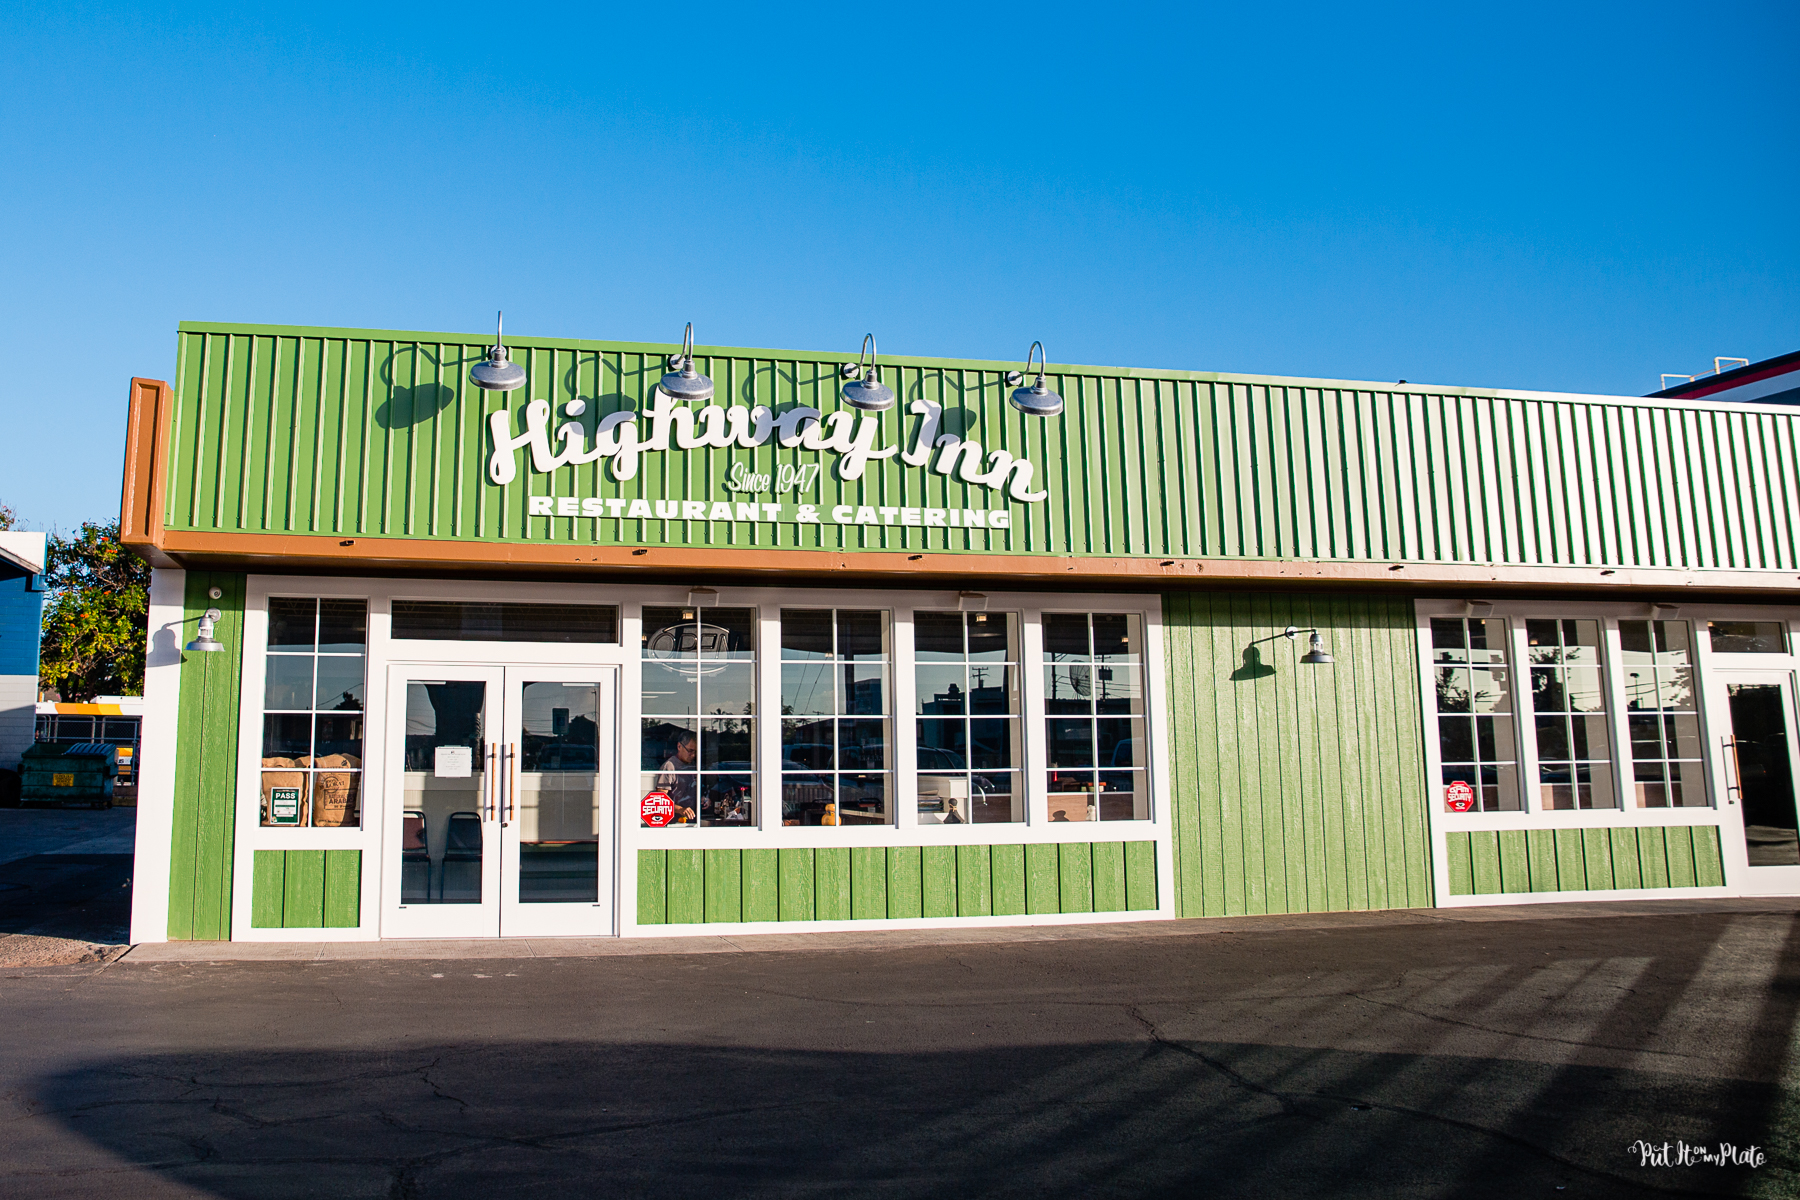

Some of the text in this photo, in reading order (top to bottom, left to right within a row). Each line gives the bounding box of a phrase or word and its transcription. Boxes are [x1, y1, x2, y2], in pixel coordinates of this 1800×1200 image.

[489, 386, 1048, 502] Highway Inn
[728, 462, 820, 494] Since 1947
[529, 496, 1009, 528] RESTAURANT & CATERING
[275, 792, 296, 800] PASS
[644, 796, 670, 806] CAM
[1447, 793, 1472, 803] SECURITY
[642, 805, 673, 816] SECURITY
